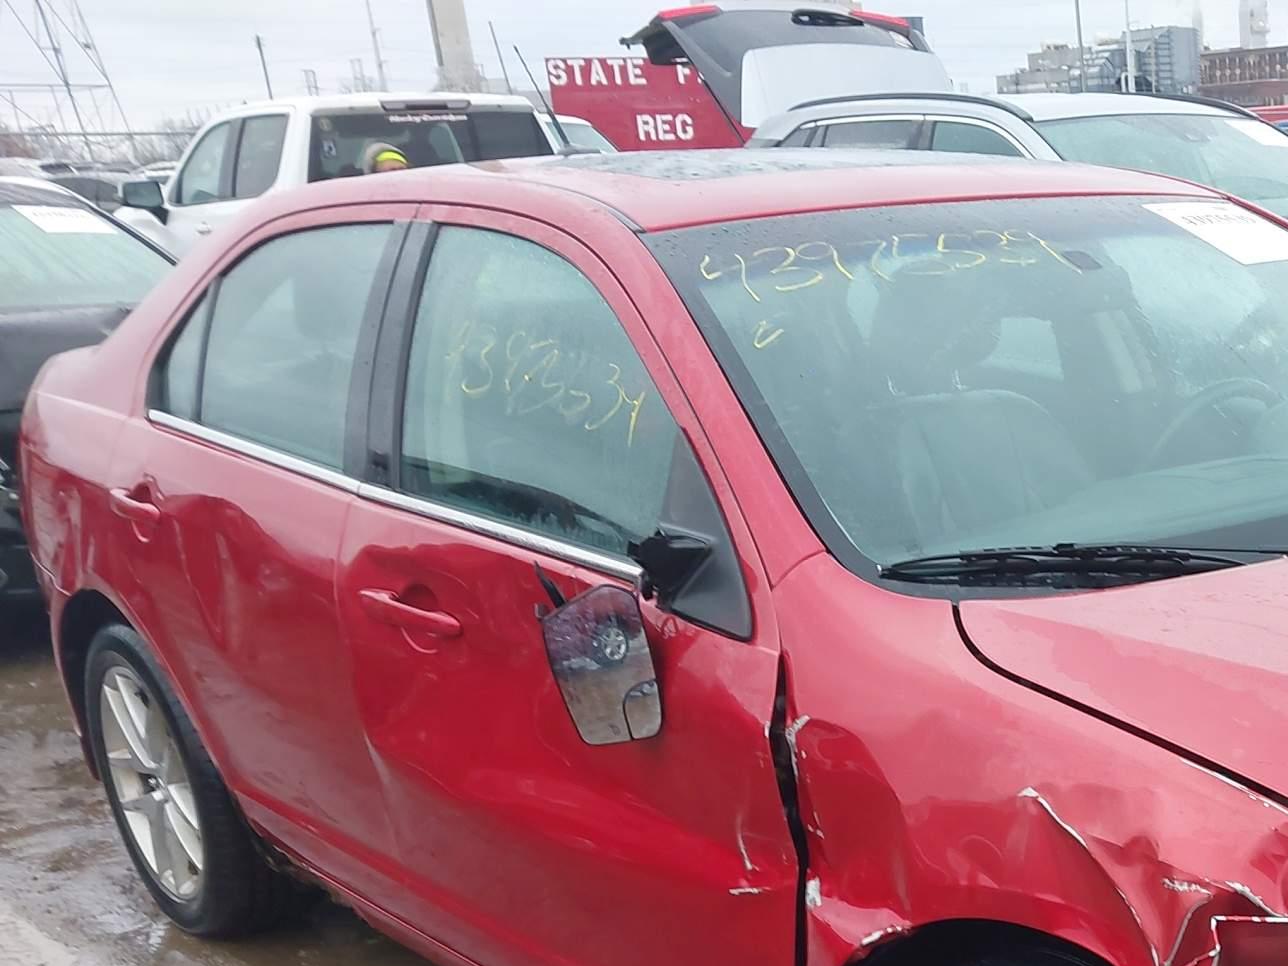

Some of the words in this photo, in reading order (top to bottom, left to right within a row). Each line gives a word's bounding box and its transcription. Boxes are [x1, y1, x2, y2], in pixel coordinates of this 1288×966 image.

[547, 57, 648, 86] STATE
[672, 57, 705, 85] F
[636, 113, 695, 142] REG
